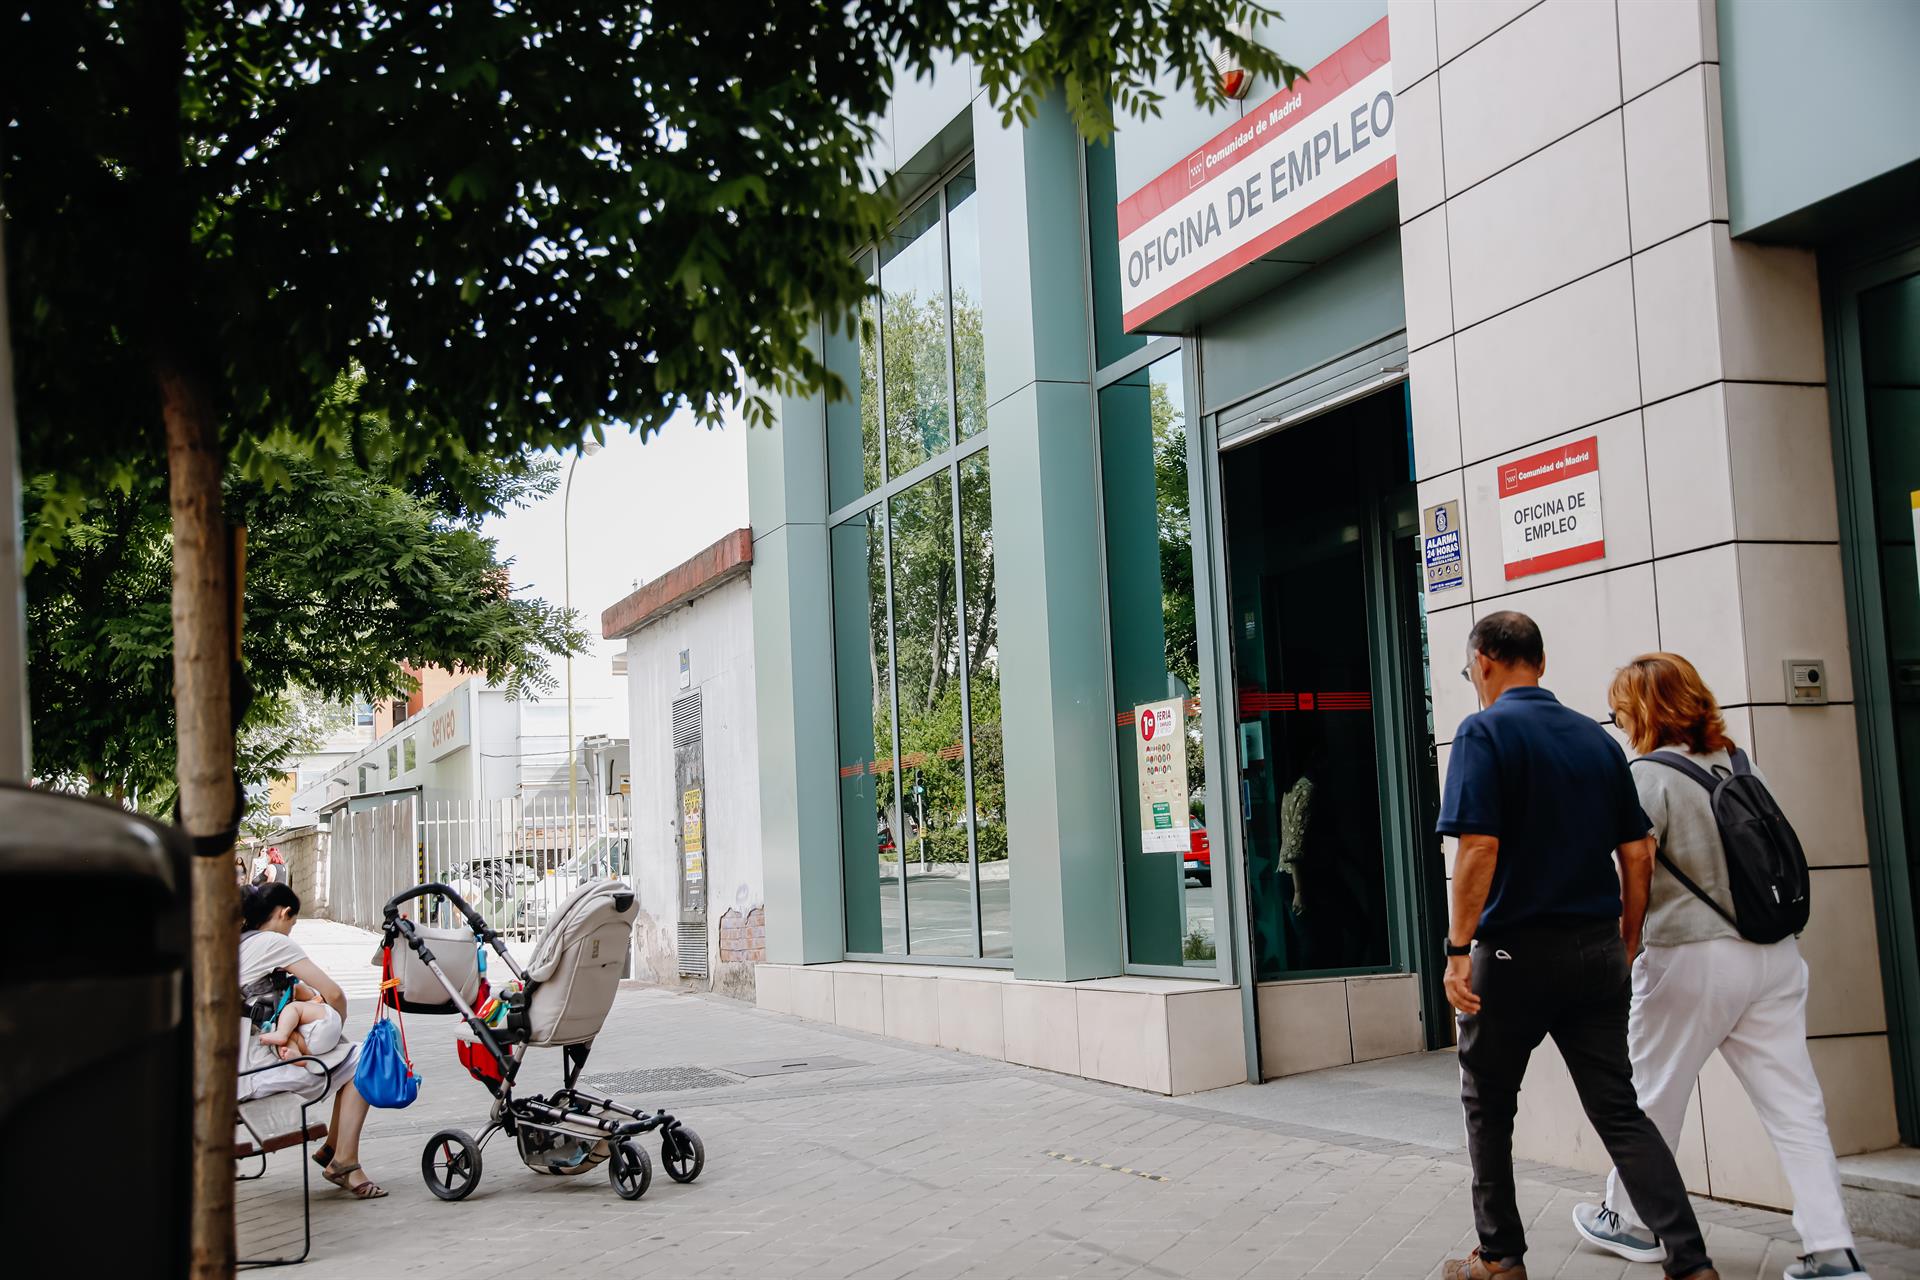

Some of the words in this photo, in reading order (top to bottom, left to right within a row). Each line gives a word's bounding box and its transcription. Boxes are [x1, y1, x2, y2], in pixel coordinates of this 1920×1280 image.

[1205, 125, 1254, 169] Comunidad
[1255, 118, 1267, 134] de
[1269, 93, 1302, 125] Madrid
[1127, 202, 1222, 288] OFICINA
[1227, 172, 1263, 230] DE
[1270, 90, 1395, 204] EMPLEO
[1518, 463, 1554, 481] Comunidad
[1555, 460, 1564, 470] de
[1565, 452, 1589, 466] Madrid
[1514, 498, 1565, 525] OFICINA
[1568, 492, 1586, 511] DE
[1426, 532, 1458, 550] ALARMA
[1524, 515, 1577, 543] EMPLEO
[1426, 549, 1436, 559] 24
[1436, 542, 1459, 556] HORAS
[432, 708, 456, 748] serveo
[1157, 709, 1171, 720] FERIA
